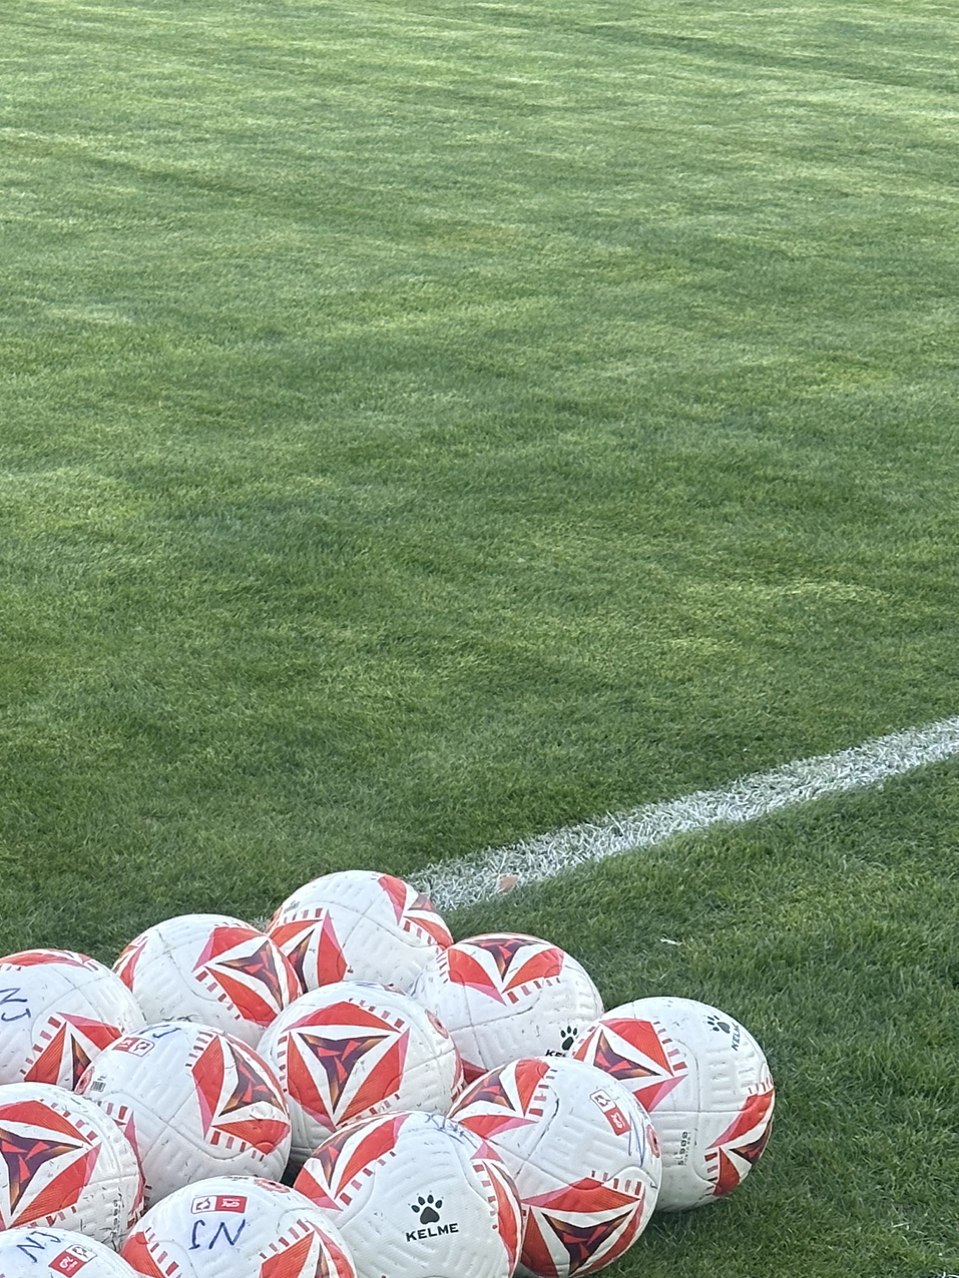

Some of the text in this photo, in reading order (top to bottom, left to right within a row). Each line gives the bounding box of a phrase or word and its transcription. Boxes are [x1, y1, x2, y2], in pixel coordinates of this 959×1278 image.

[16, 1231, 61, 1263] NJ
[189, 1219, 245, 1249] NJ
[406, 1223, 459, 1242] KELME
